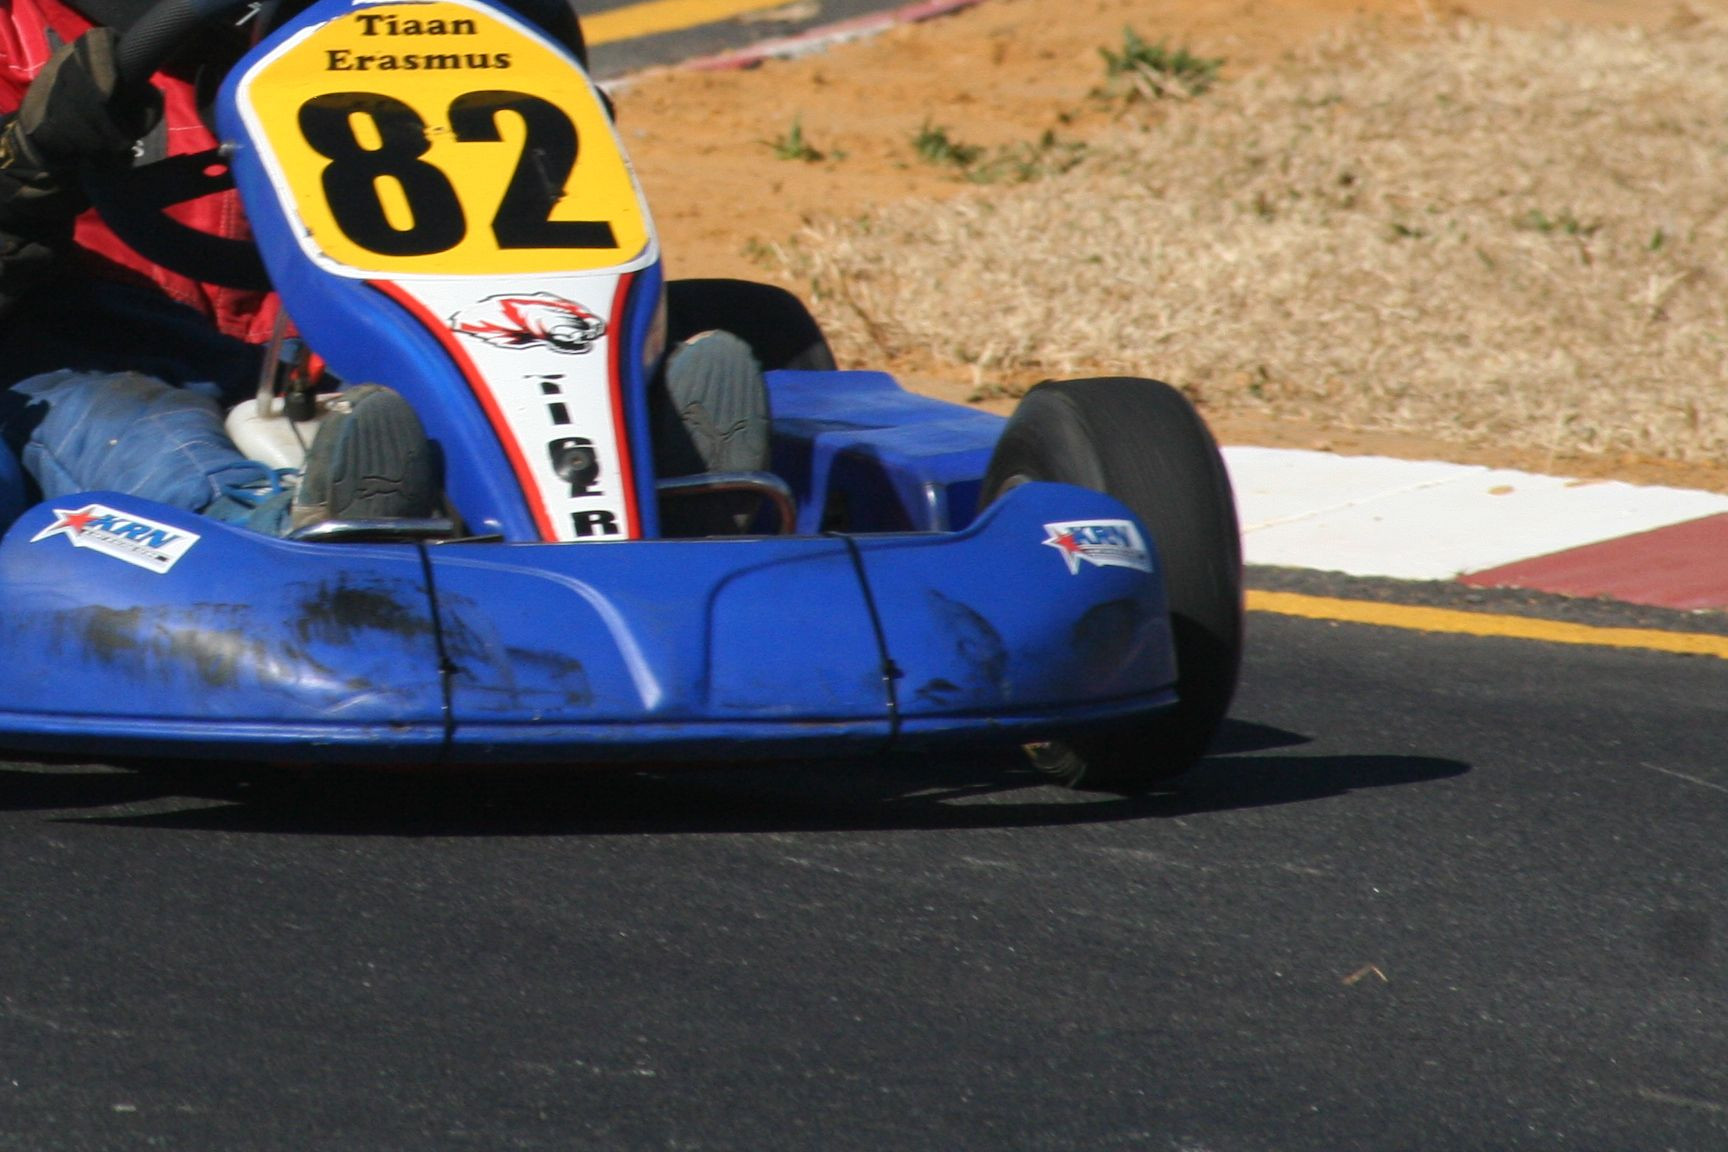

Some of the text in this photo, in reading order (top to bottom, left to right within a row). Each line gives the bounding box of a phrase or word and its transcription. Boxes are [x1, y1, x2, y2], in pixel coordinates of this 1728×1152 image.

[356, 13, 478, 36] Tiaan
[325, 48, 512, 72] Erasmus
[297, 89, 619, 257] 82
[87, 514, 180, 549] KRN
